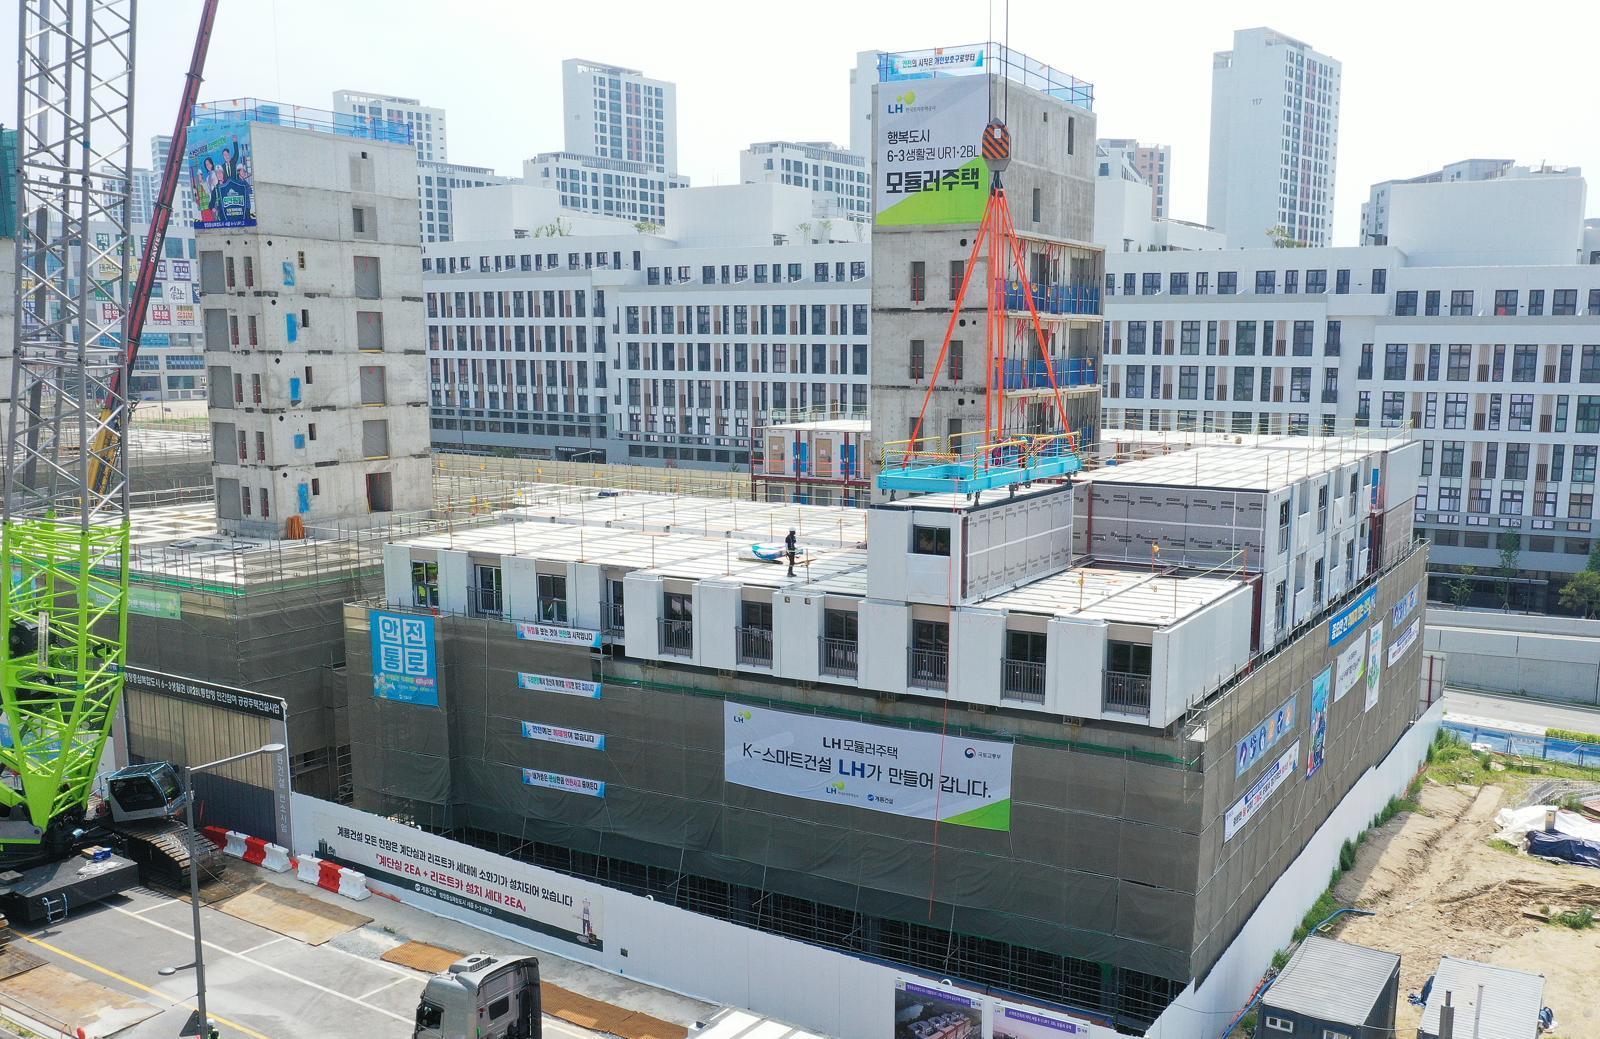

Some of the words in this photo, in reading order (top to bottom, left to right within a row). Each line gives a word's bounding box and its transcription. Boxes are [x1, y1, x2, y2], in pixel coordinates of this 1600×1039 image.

[888, 104, 903, 114] LH
[887, 129, 930, 145] 행복도시
[886, 168, 979, 194] 모듈러주택
[380, 617, 425, 646] 안전
[383, 646, 426, 674] 통로
[238, 695, 280, 714] 공공주택건설사업
[734, 715, 744, 724] LH
[823, 736, 841, 750] LH
[843, 739, 898, 759] 모듈러주택
[742, 742, 832, 773] K-스마트건설
[838, 759, 882, 781] LH가
[888, 768, 934, 790] 만들어
[940, 774, 992, 799] 갑니다.
[826, 786, 836, 794] LH
[337, 826, 362, 842] 계룡건설
[365, 834, 377, 847] 모든
[378, 838, 398, 853] 현장은
[400, 844, 426, 861] 계단실과
[428, 852, 455, 871] 리프트카
[457, 861, 477, 878] 세대에
[479, 869, 508, 886] 소화기가
[509, 879, 540, 898] 설치되어
[541, 888, 573, 907] 있습니다
[404, 863, 421, 876] 2EA
[430, 870, 463, 890] 리프트카
[465, 882, 482, 897] 설치
[485, 888, 502, 903] 세대
